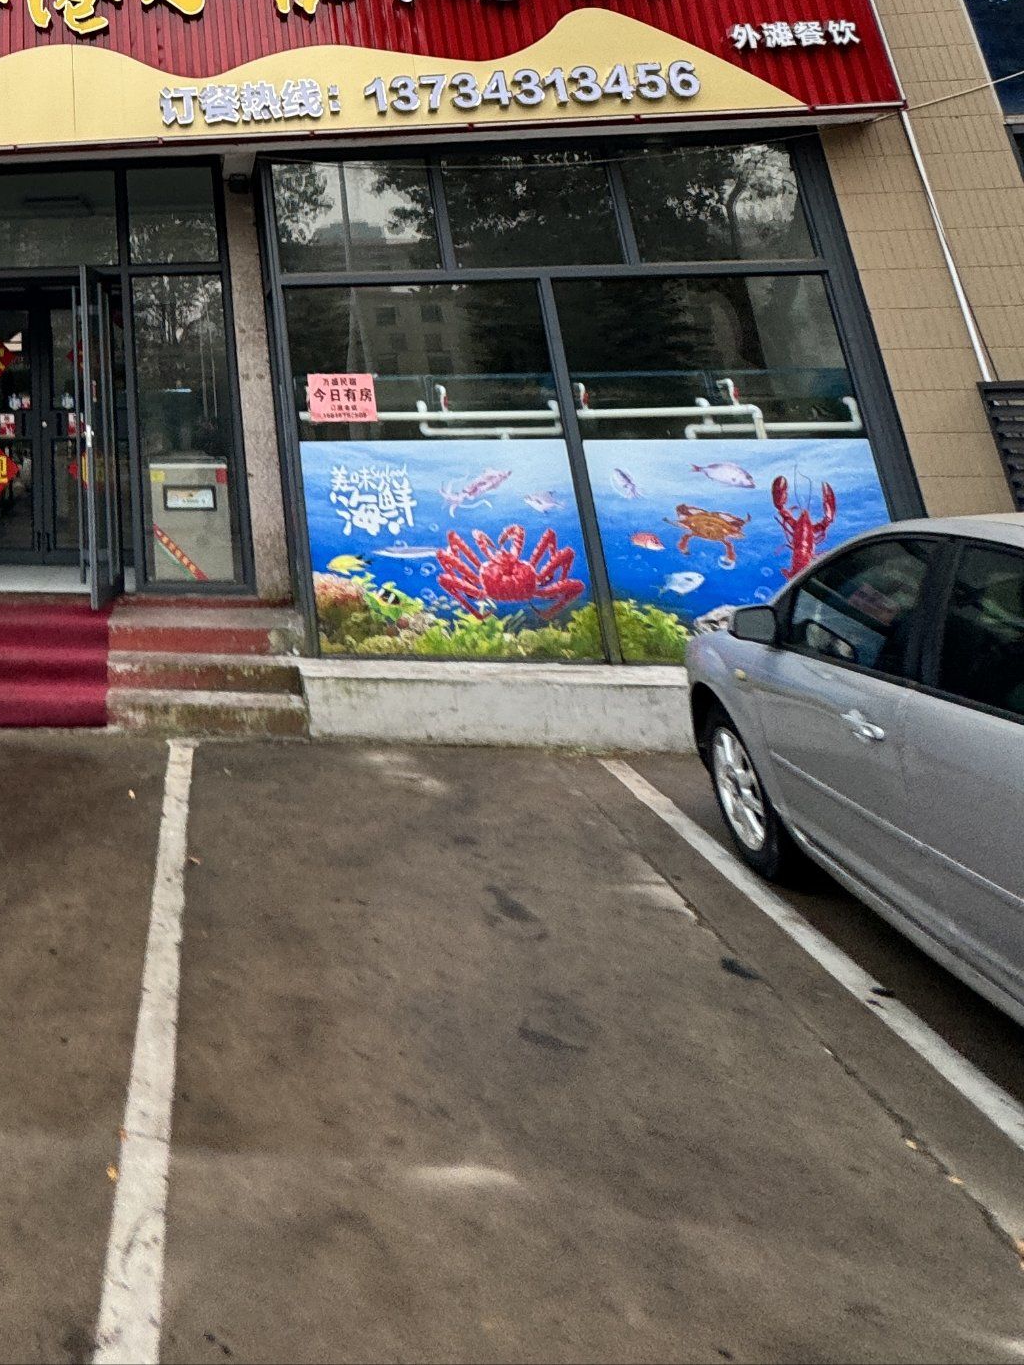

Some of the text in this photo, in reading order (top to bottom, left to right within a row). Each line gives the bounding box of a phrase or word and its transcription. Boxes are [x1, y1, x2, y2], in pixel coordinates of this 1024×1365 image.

[731, 20, 861, 50] 外滩餐饮
[362, 60, 702, 114] 13734313456
[313, 387, 373, 403] 今日有房
[329, 476, 418, 536] 海鲜
